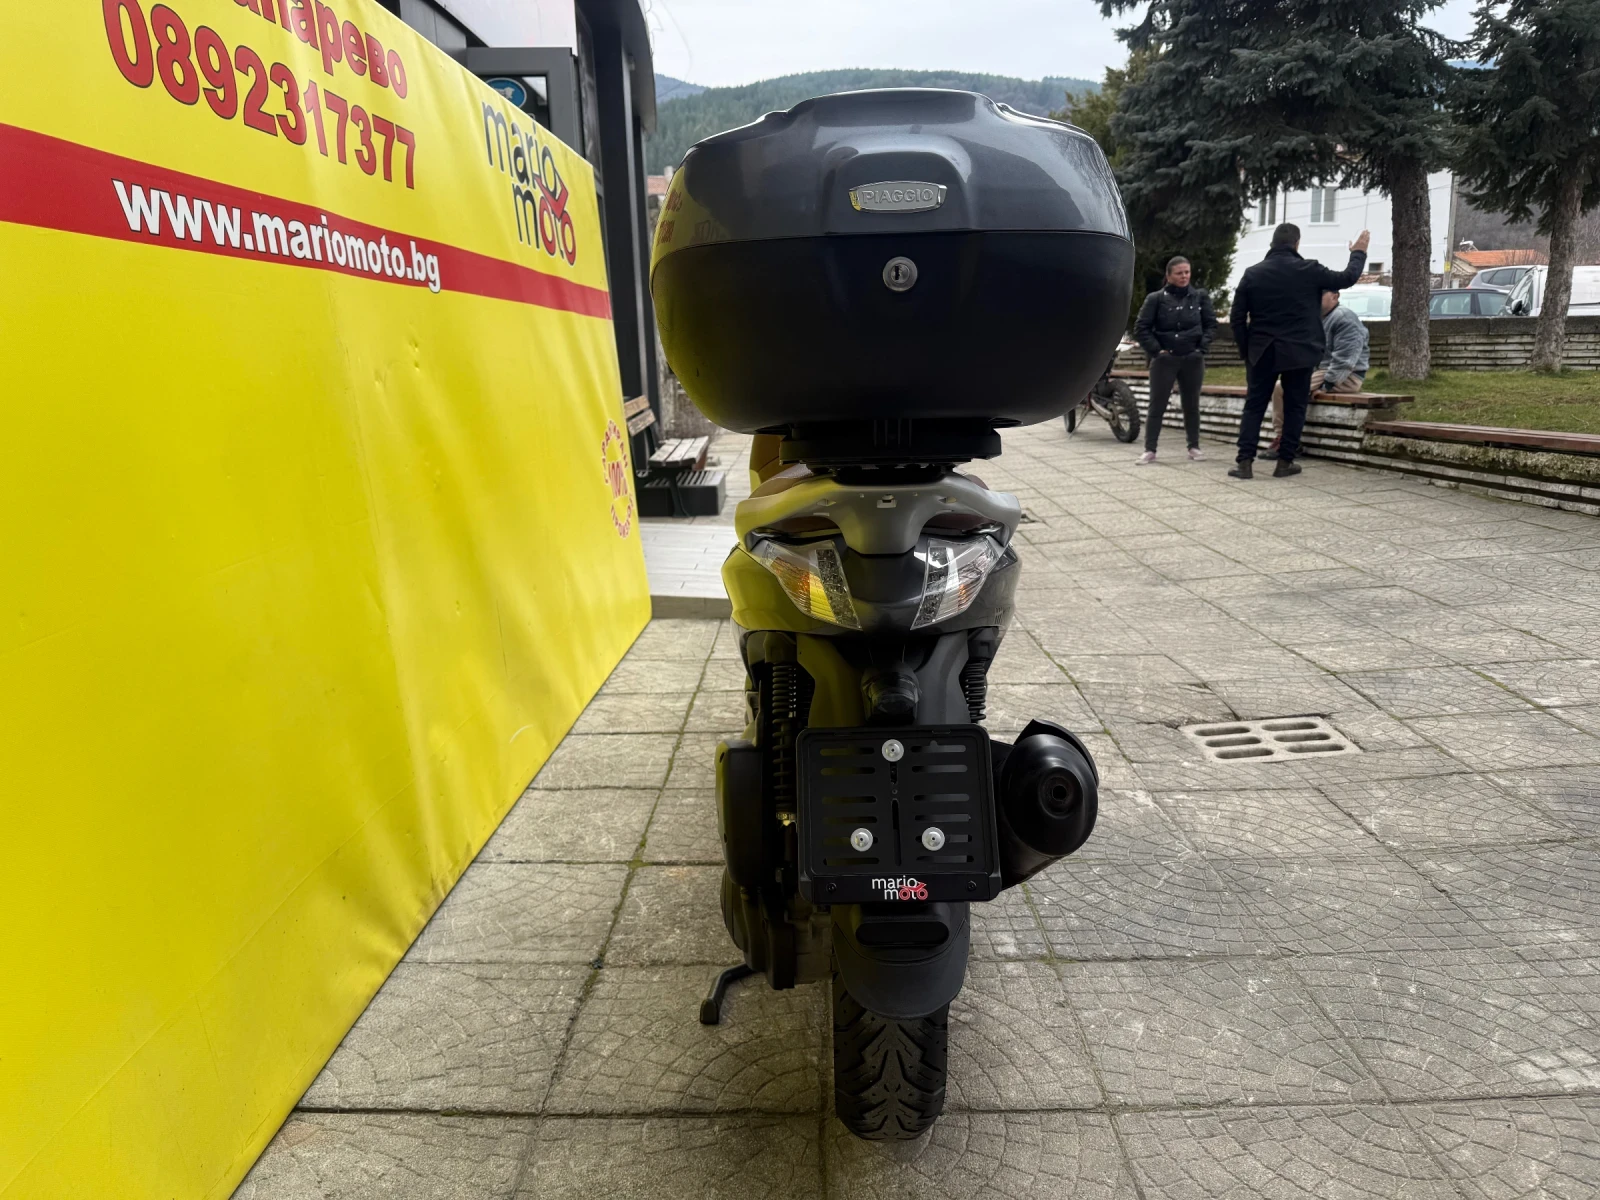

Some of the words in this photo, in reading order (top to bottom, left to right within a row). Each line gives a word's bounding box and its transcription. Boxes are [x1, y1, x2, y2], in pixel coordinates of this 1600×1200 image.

[102, 0, 416, 190] 0892317377
[482, 101, 557, 199] mario
[861, 188, 934, 204] PIAGGIO
[111, 178, 441, 293] www.mariomoto.bg
[871, 875, 918, 889] mario
[884, 888, 928, 900] moto
